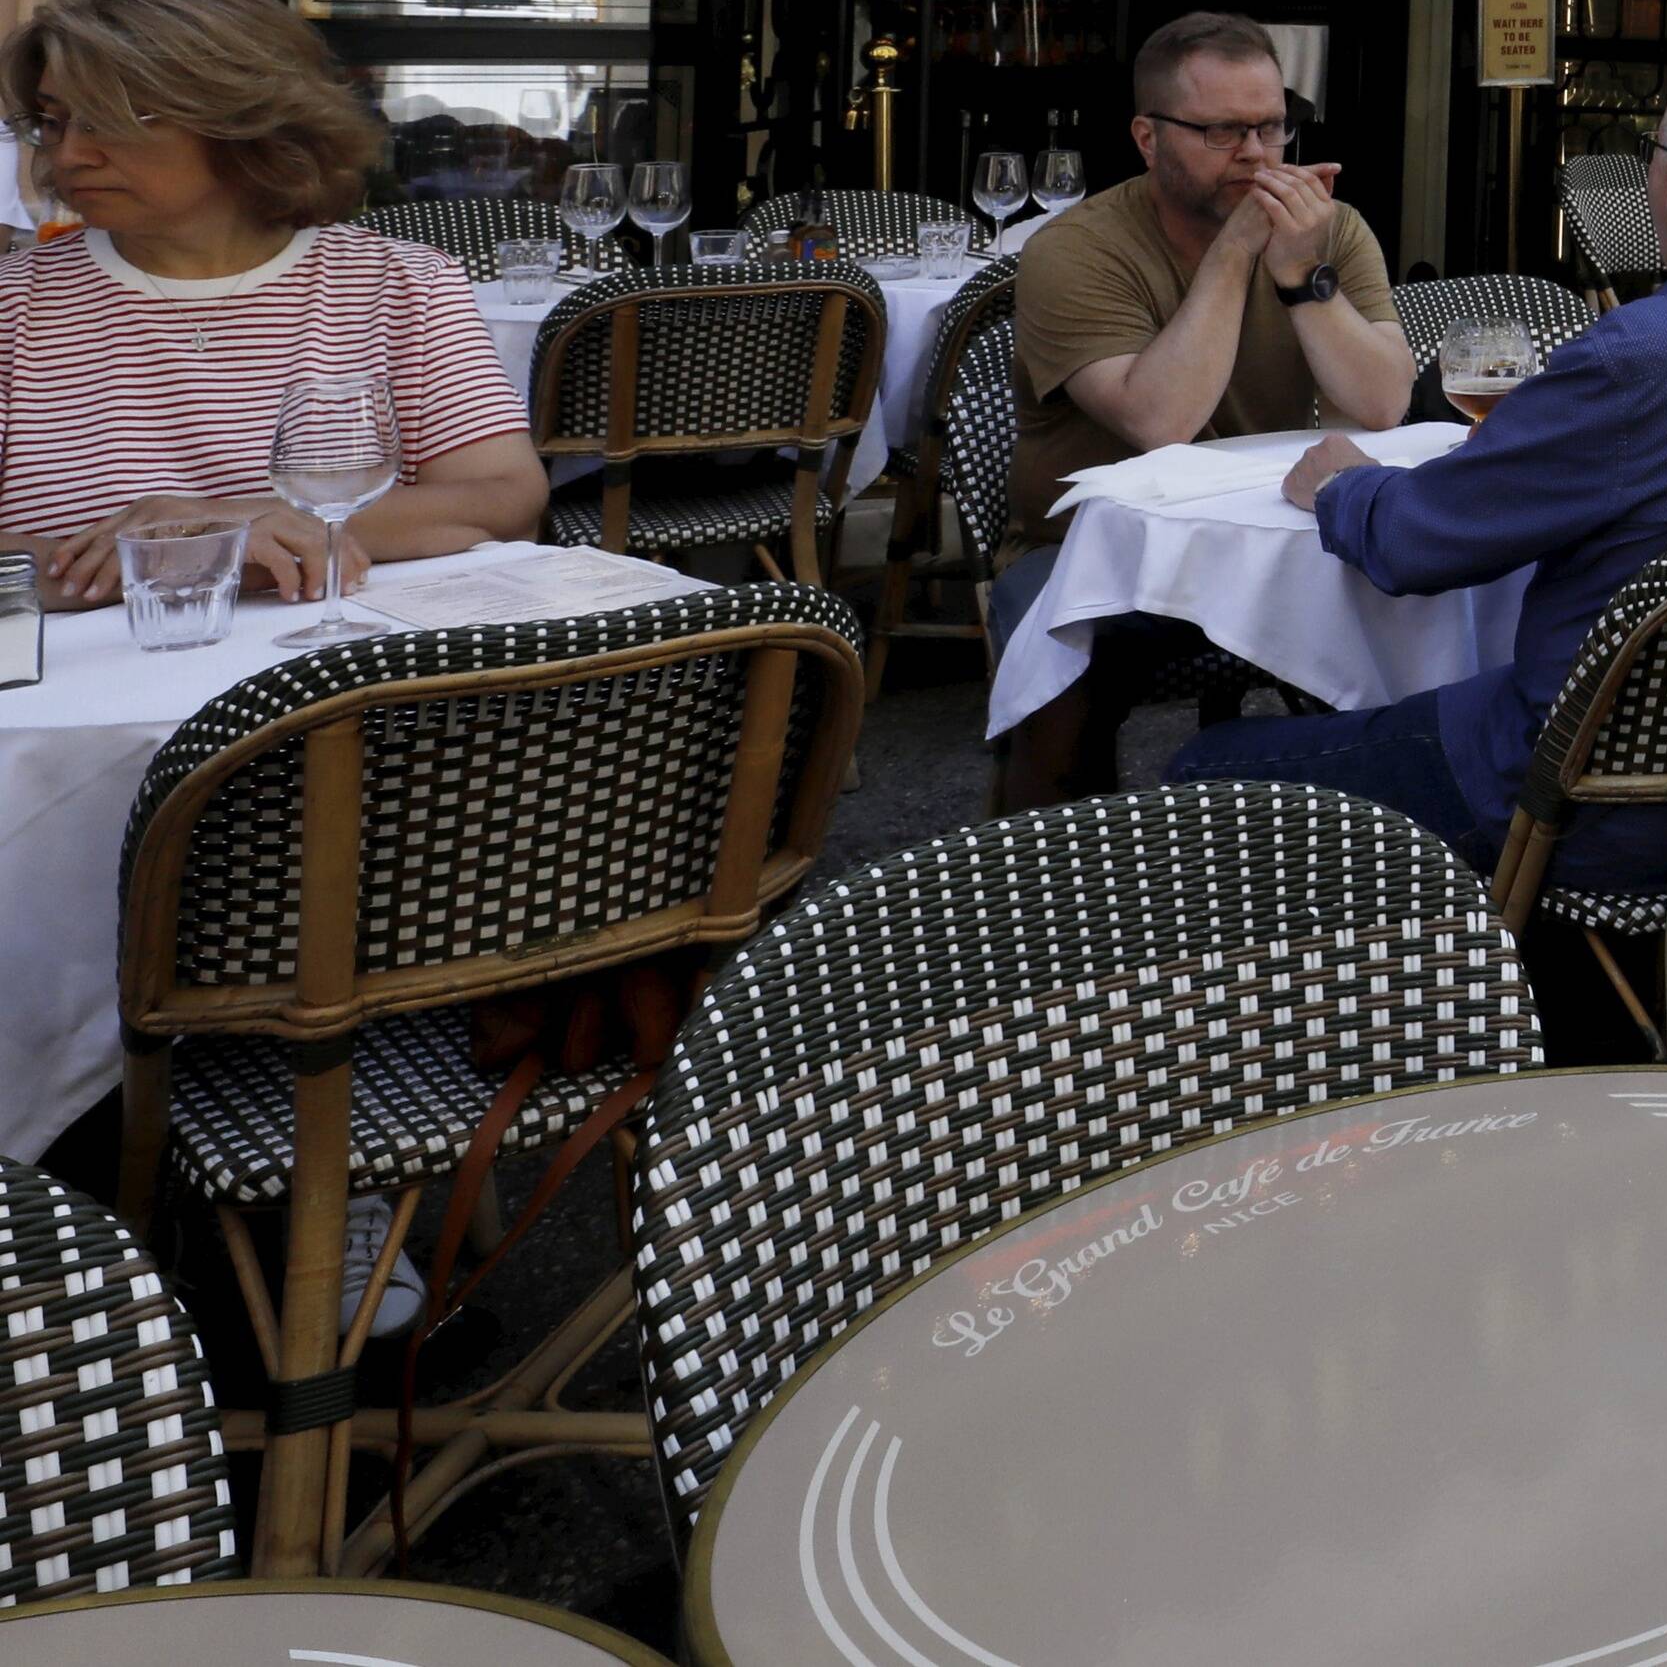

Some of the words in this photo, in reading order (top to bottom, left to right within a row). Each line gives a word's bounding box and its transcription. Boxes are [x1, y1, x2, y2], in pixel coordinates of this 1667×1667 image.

[1493, 18, 1516, 29] WAIT
[1520, 18, 1544, 29] HERE
[1504, 32, 1515, 42] TO
[1518, 32, 1531, 42] BE
[1501, 45, 1536, 56] SEATED
[1203, 1190, 1303, 1236] NICE
[932, 1305, 1015, 1358] Le
[992, 1202, 1163, 1307] Grand
[1171, 1160, 1283, 1213] Café
[1296, 1140, 1353, 1173] de
[1363, 1110, 1539, 1156] France
